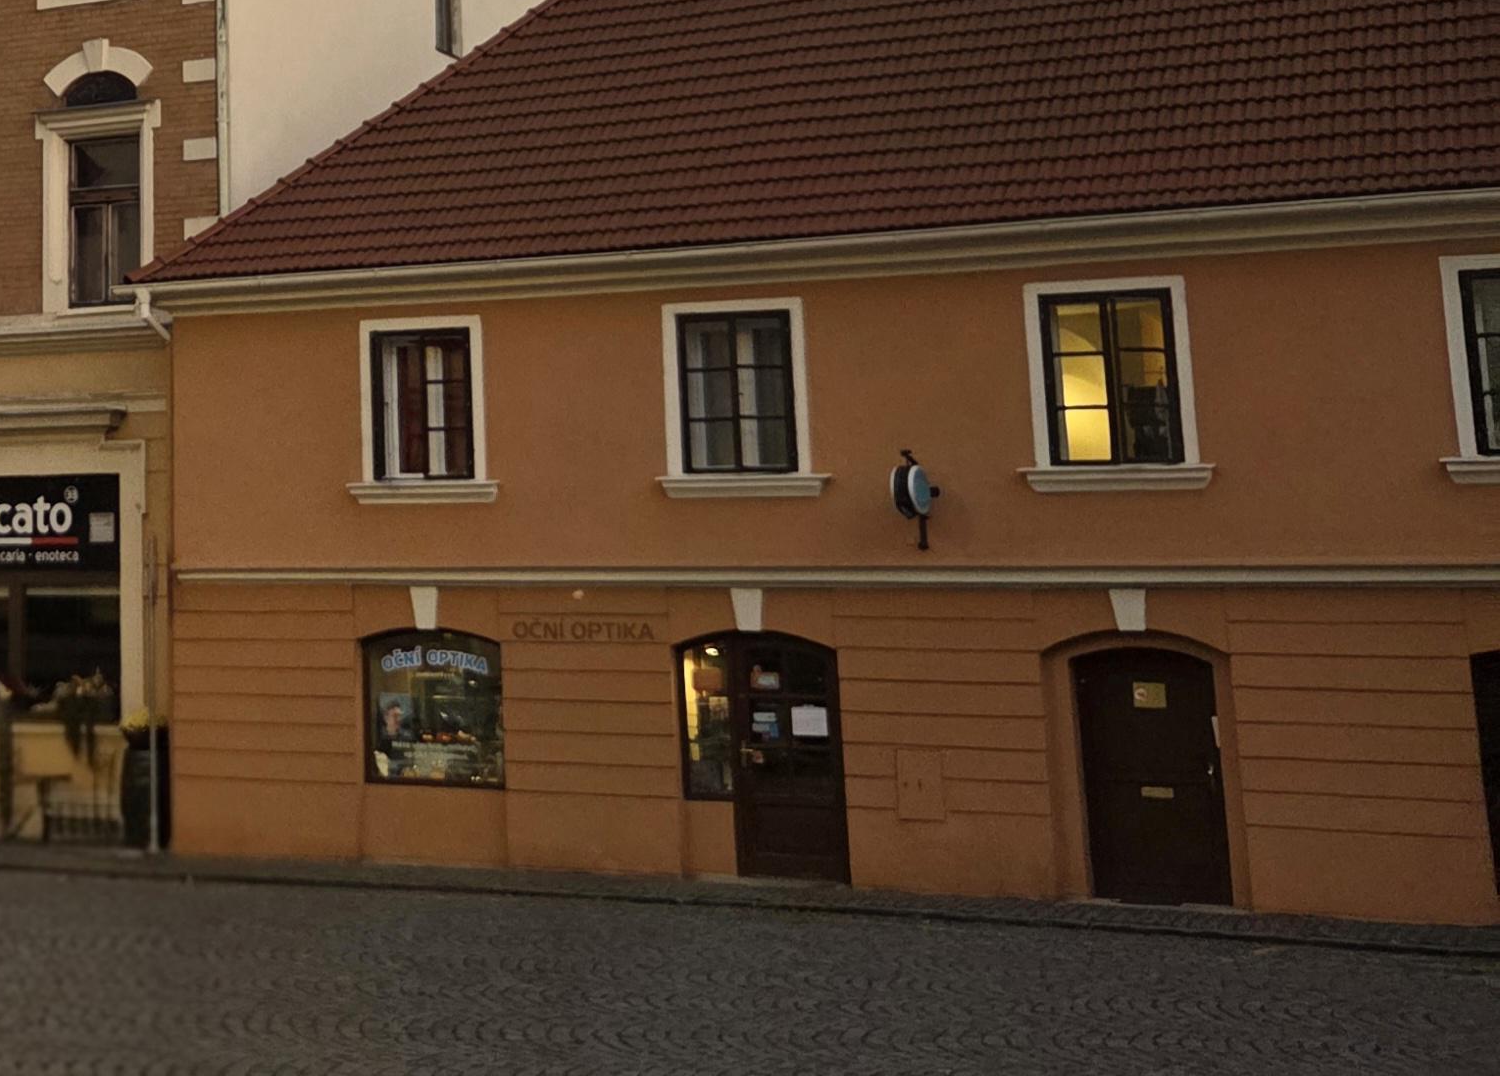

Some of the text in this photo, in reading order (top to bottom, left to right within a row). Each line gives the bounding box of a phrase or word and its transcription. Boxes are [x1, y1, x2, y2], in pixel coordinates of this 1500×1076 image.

[35, 548, 79, 562] enoteca
[512, 616, 654, 640] OČNÍ OPTIKA
[381, 646, 488, 675] OČNÍ OPTIKA
